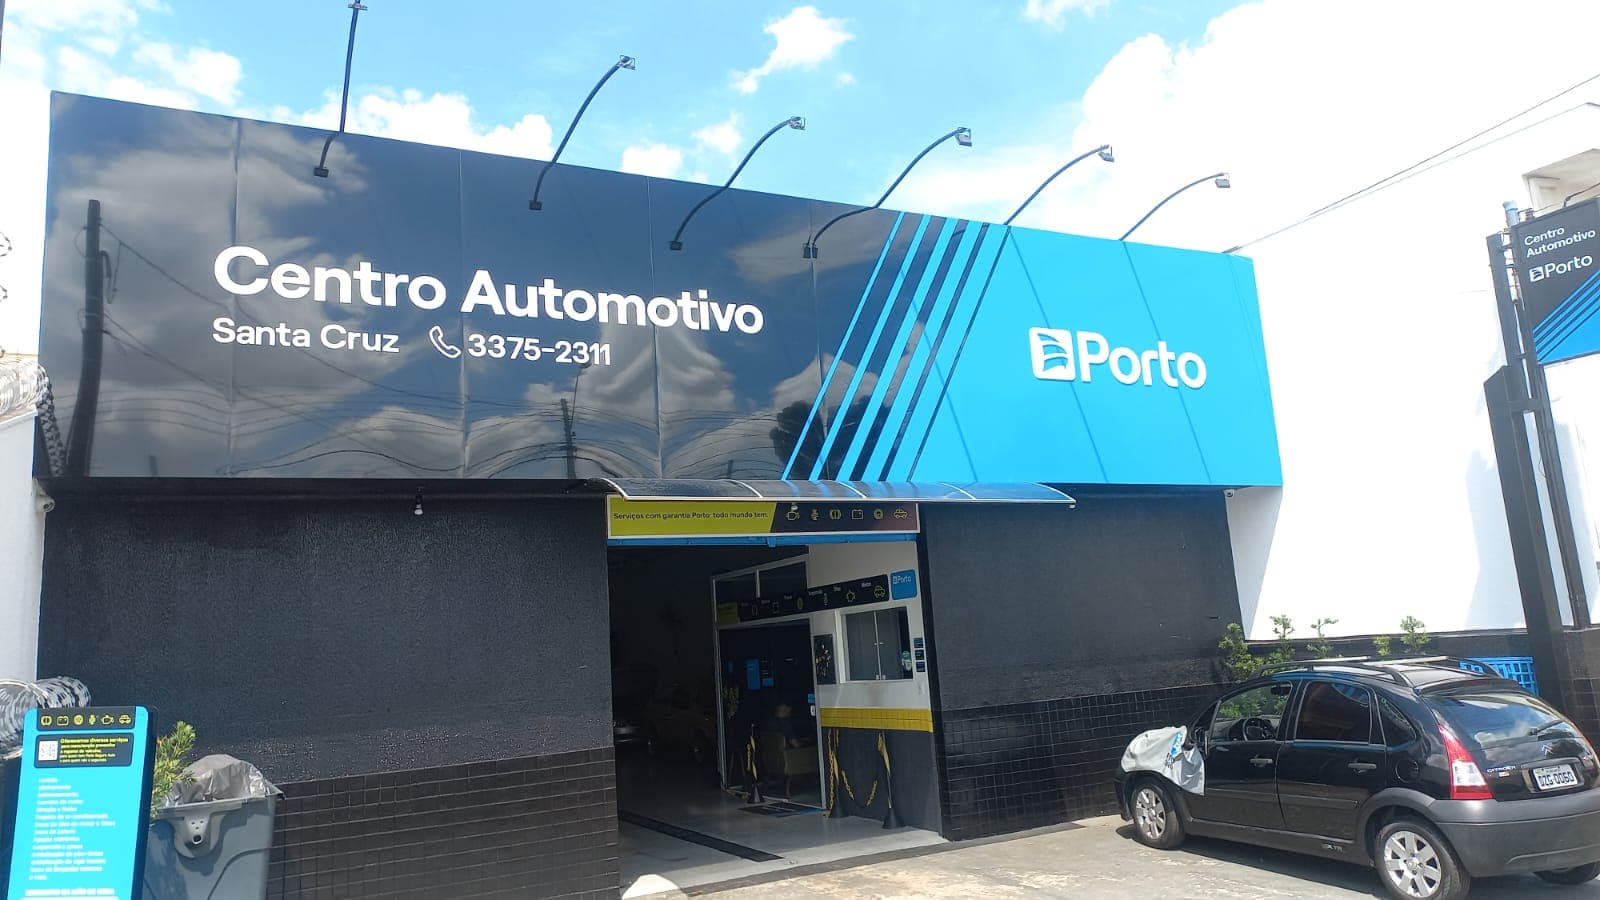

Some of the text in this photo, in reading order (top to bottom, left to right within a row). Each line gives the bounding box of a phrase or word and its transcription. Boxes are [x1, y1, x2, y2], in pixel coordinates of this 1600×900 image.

[1524, 227, 1565, 246] Centro
[1526, 230, 1596, 258] Automotivo
[1544, 255, 1593, 278] Porto
[213, 245, 765, 334] Centro Automotivo
[212, 317, 612, 366] Santa Cruz 3375-2311
[1076, 330, 1208, 390] Porto
[613, 512, 644, 521] Serviços
[662, 512, 691, 521] garantia
[730, 511, 753, 519] mundo
